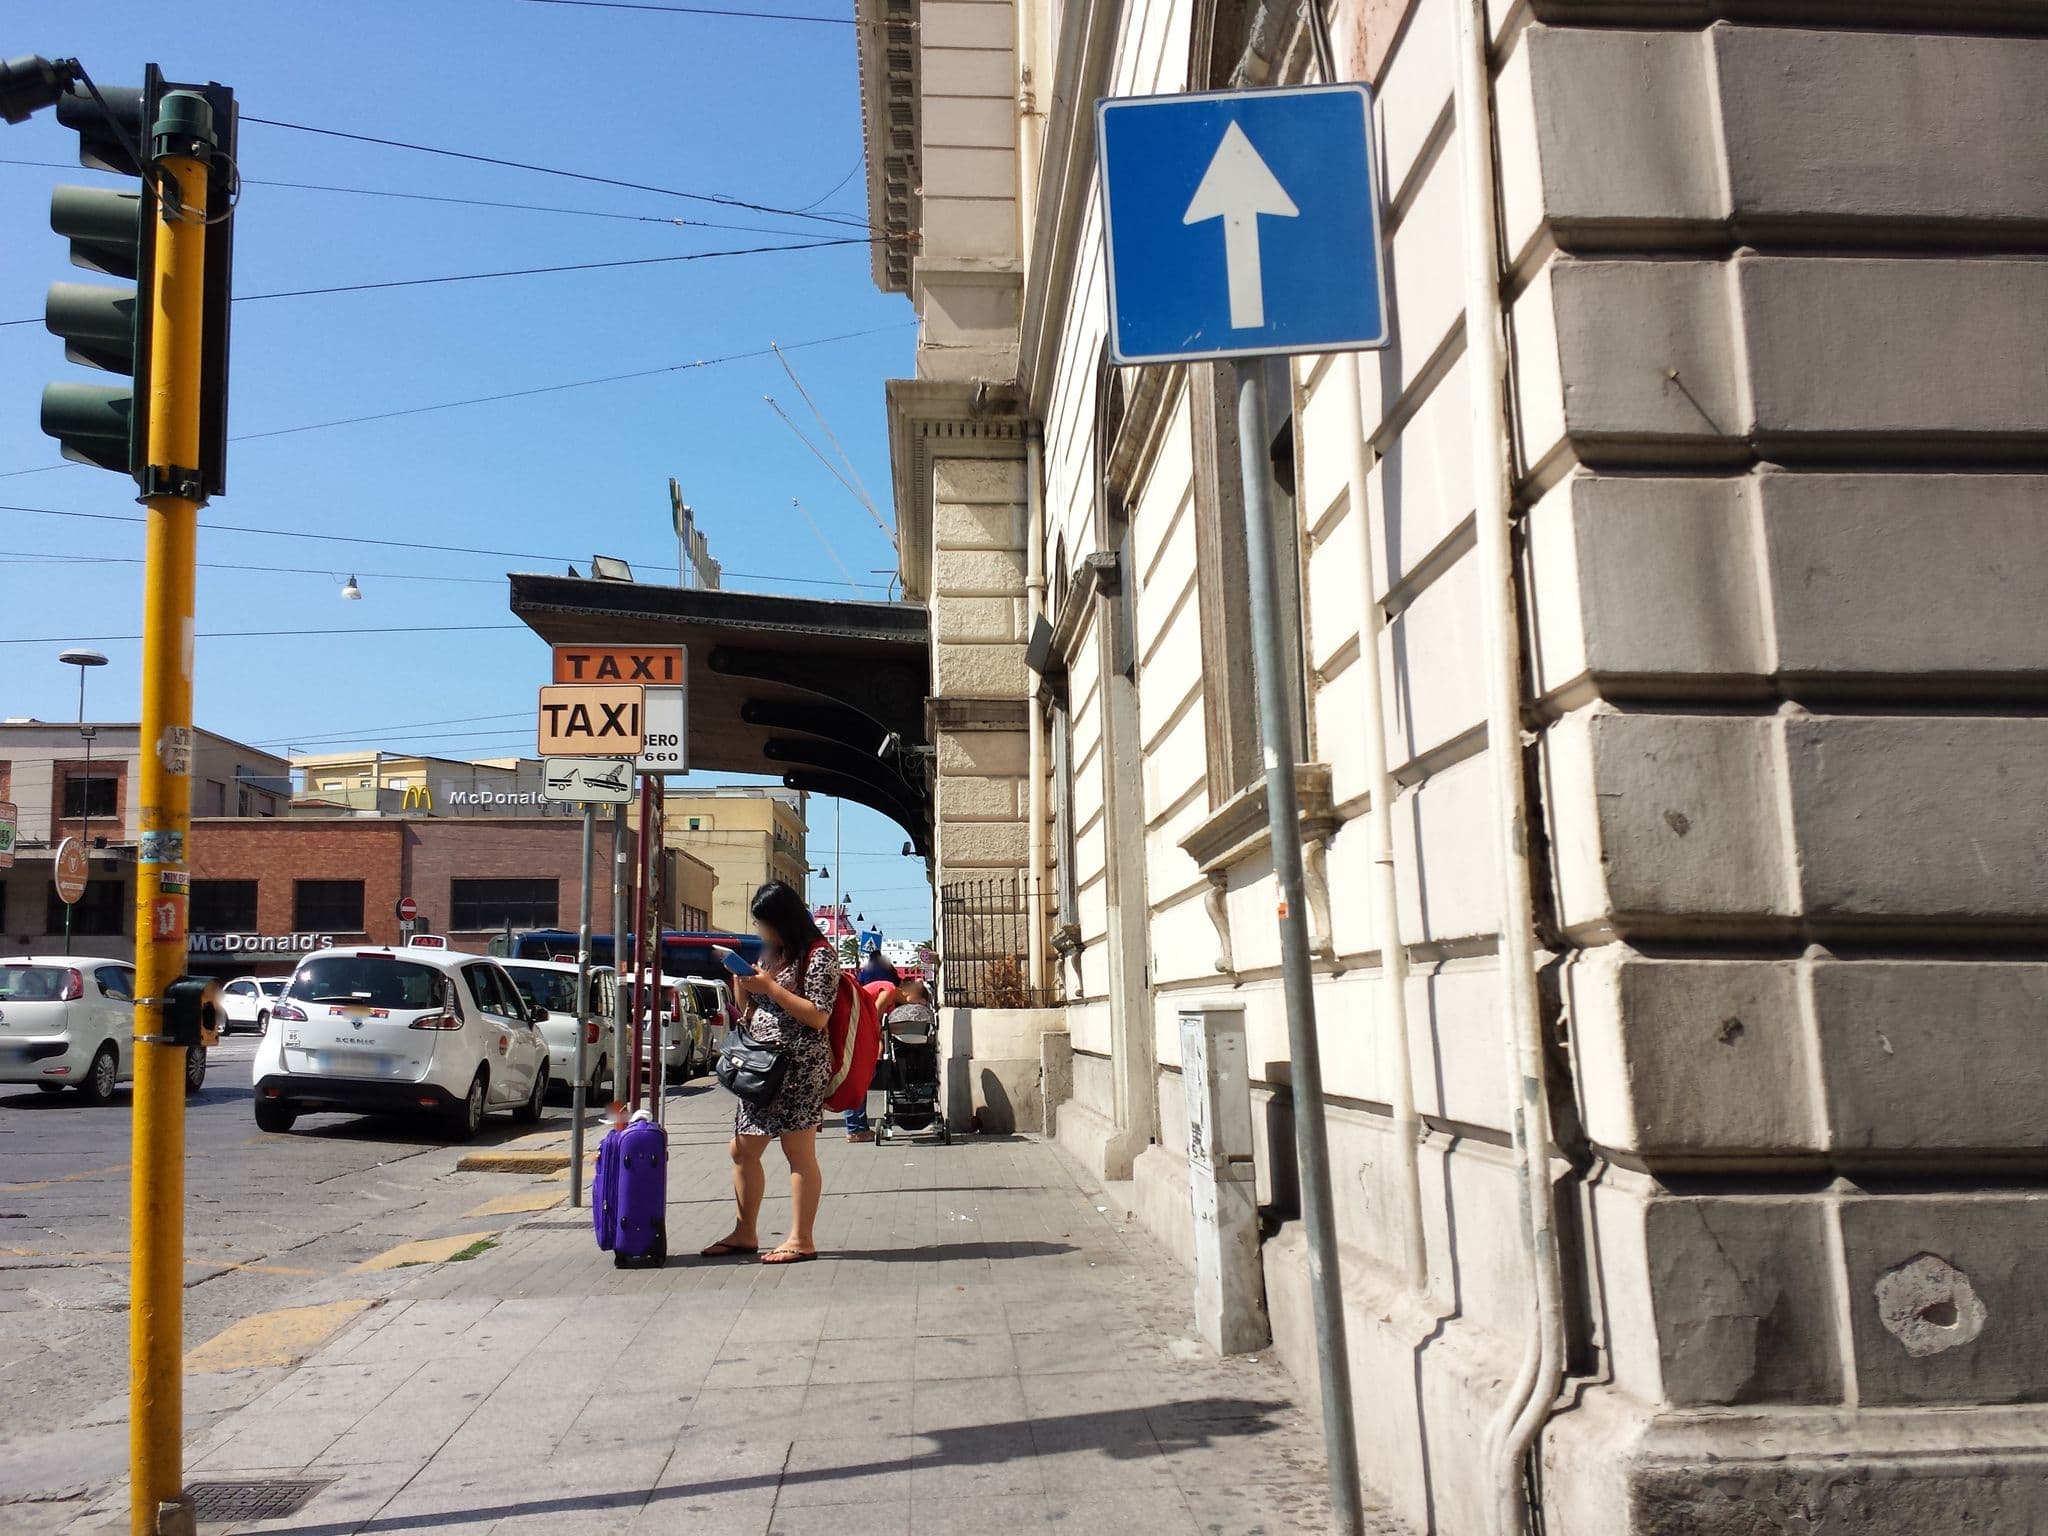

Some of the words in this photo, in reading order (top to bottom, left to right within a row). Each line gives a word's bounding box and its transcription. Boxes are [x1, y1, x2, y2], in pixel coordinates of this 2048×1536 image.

[566, 655, 673, 680] TAXI
[542, 703, 639, 737] TAXI
[644, 752, 679, 762] 660
[449, 791, 561, 805] McDonal
[188, 934, 334, 951] McDonald's
